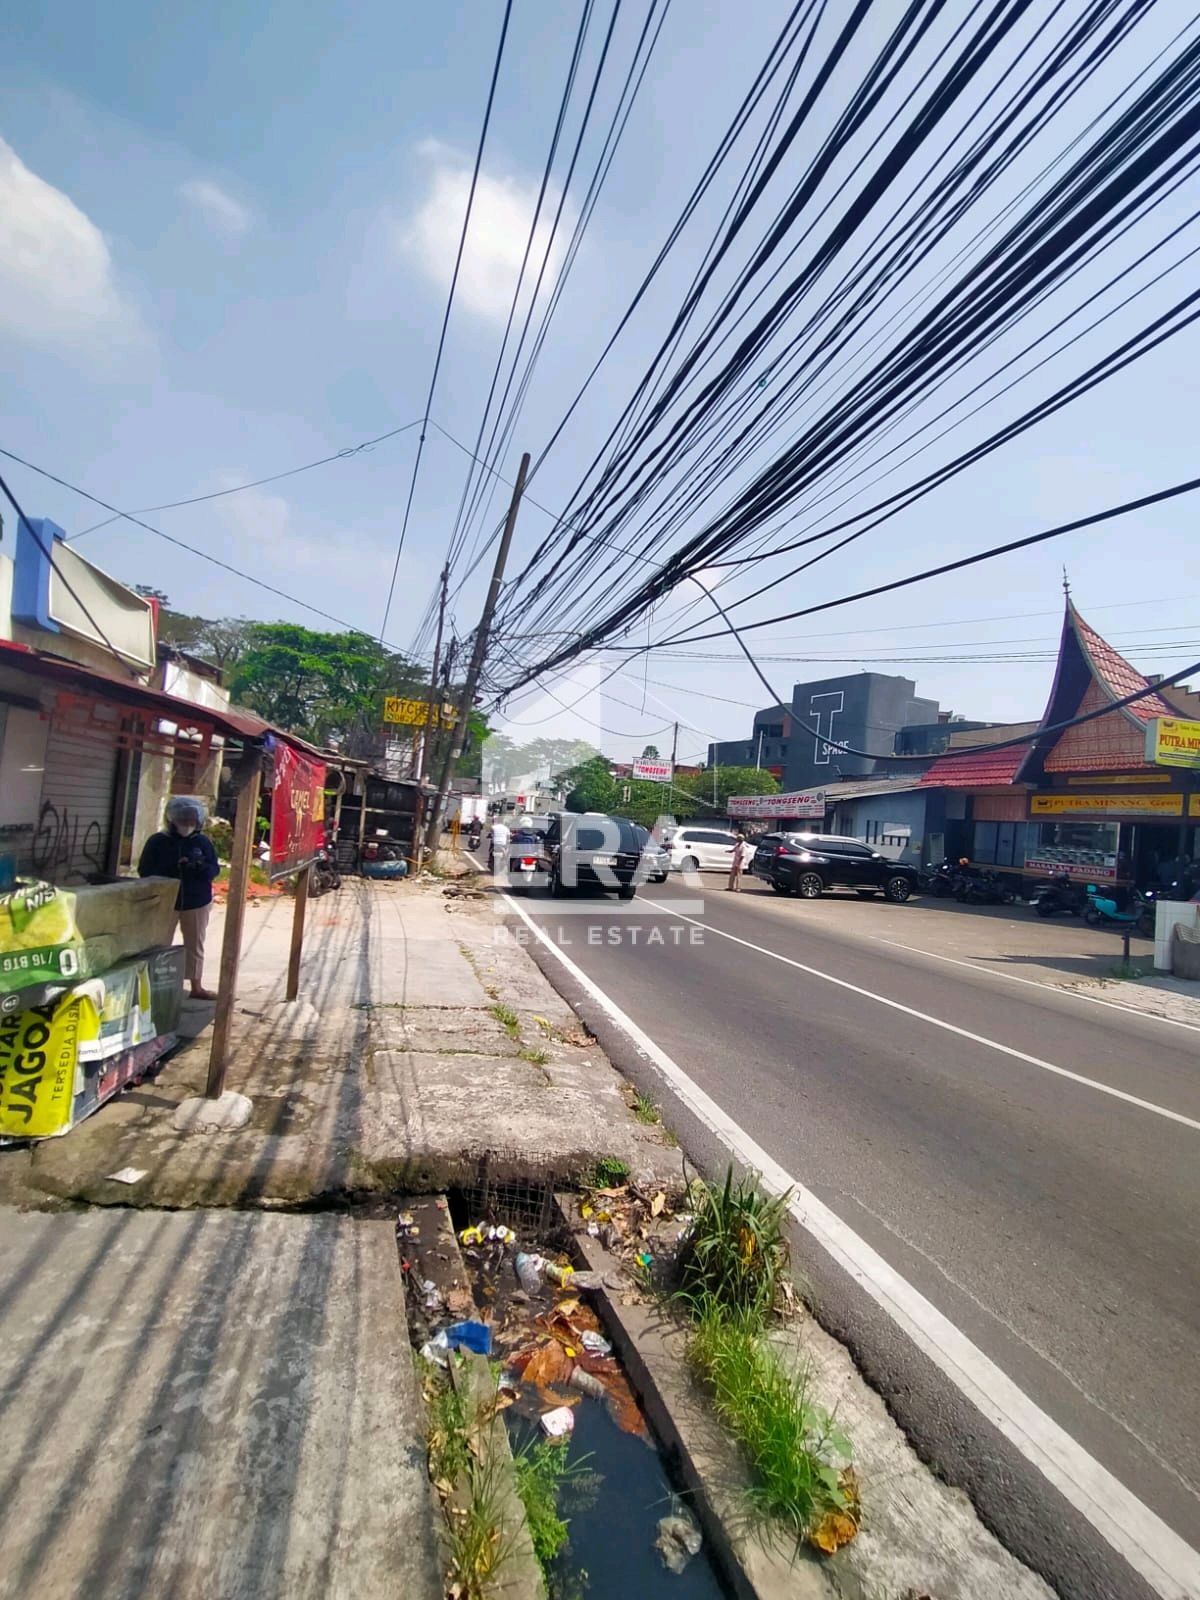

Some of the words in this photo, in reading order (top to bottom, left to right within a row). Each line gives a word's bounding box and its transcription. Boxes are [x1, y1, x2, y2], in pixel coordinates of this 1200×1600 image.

[1160, 734, 1185, 747] PUTRA
[822, 741, 849, 756] SPACE
[767, 796, 810, 805] TONGSENG
[1094, 799, 1145, 808] MINANG
[1030, 862, 1072, 873] MASAKAN
[53, 1035, 74, 1101] TERSEDIA
